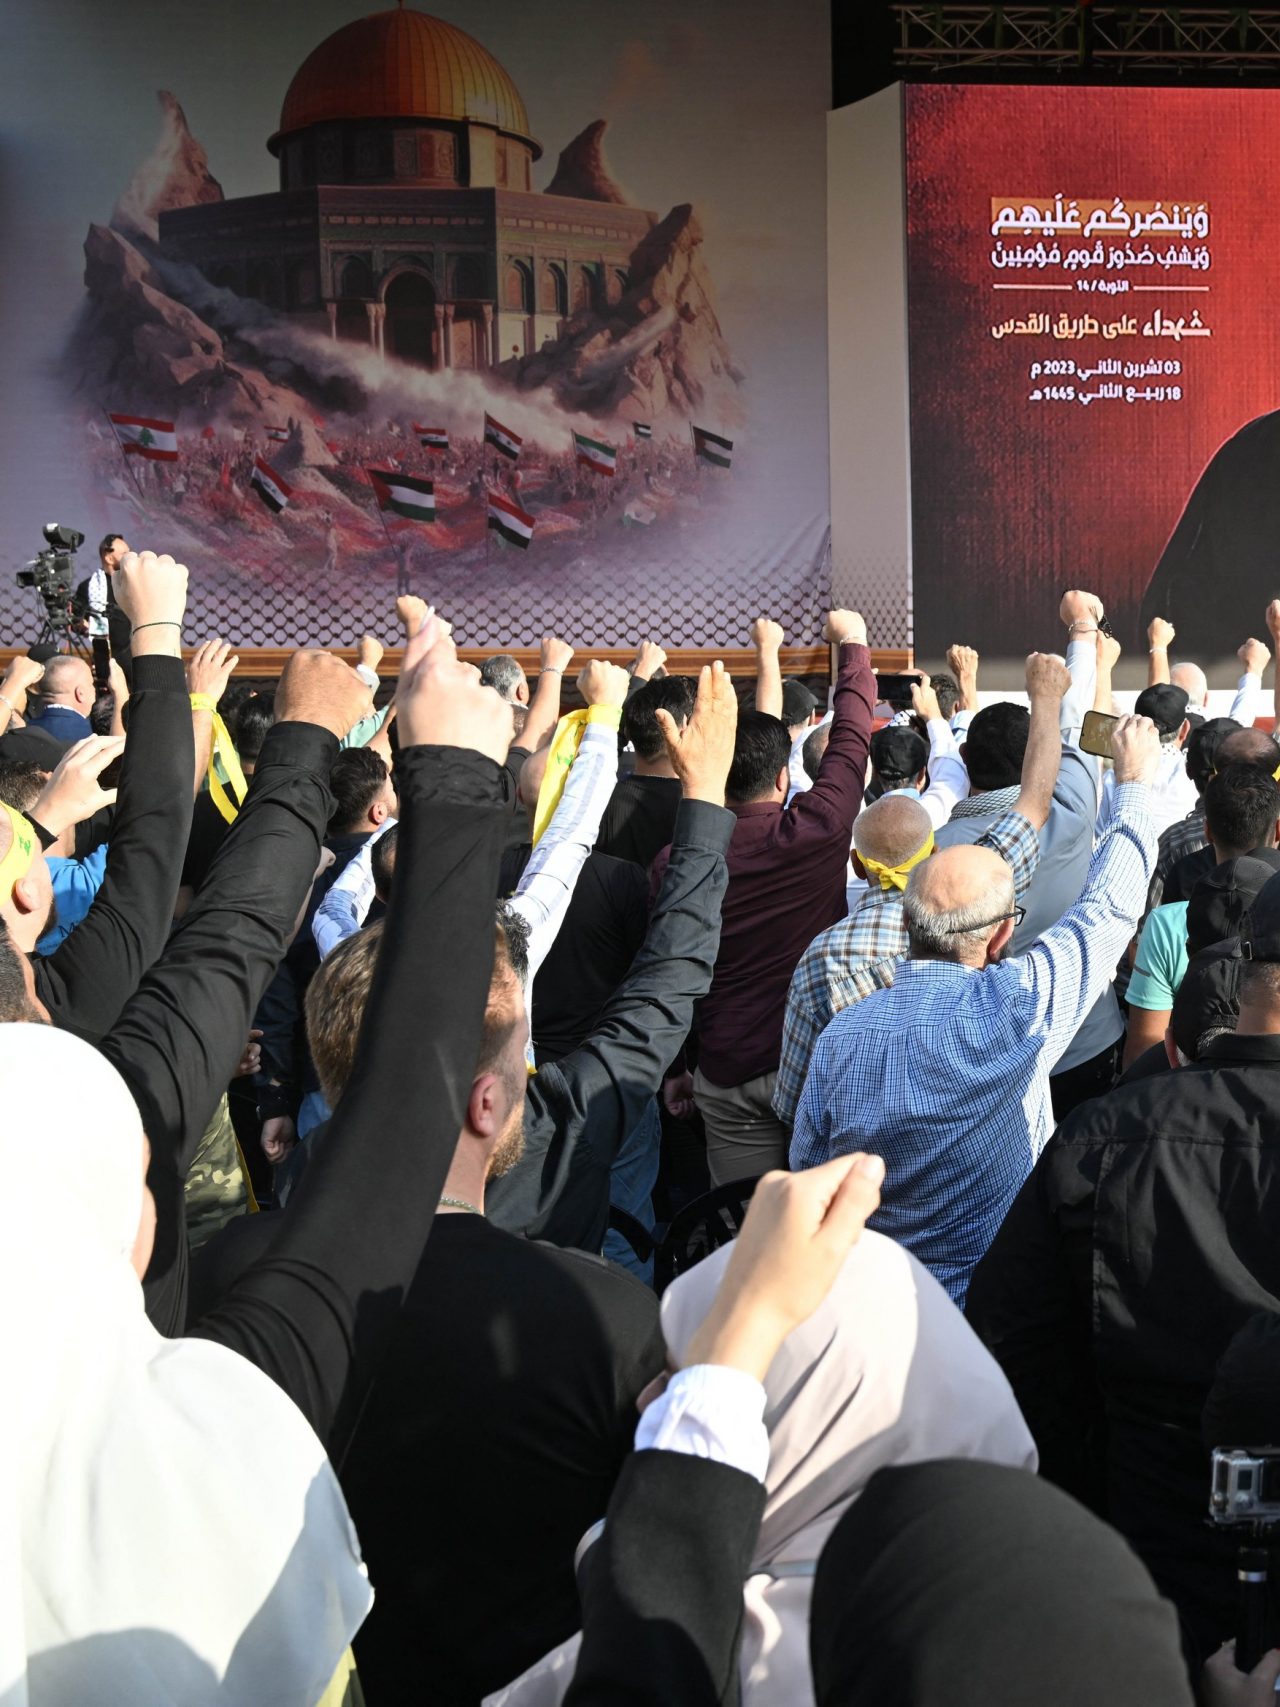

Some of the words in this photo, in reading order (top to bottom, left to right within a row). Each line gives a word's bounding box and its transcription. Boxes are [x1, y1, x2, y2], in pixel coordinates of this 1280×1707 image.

[991, 313, 1050, 339] القدس
[1052, 313, 1099, 339] طريق
[1102, 314, 1137, 339] على
[1142, 309, 1211, 341] شهداء
[1043, 360, 1076, 375] 2023
[1077, 358, 1122, 382] الثاني
[1123, 358, 1163, 379] تشرين
[1163, 360, 1181, 375] 03
[1078, 382, 1123, 405] الثاني
[1165, 386, 1182, 401] 18
